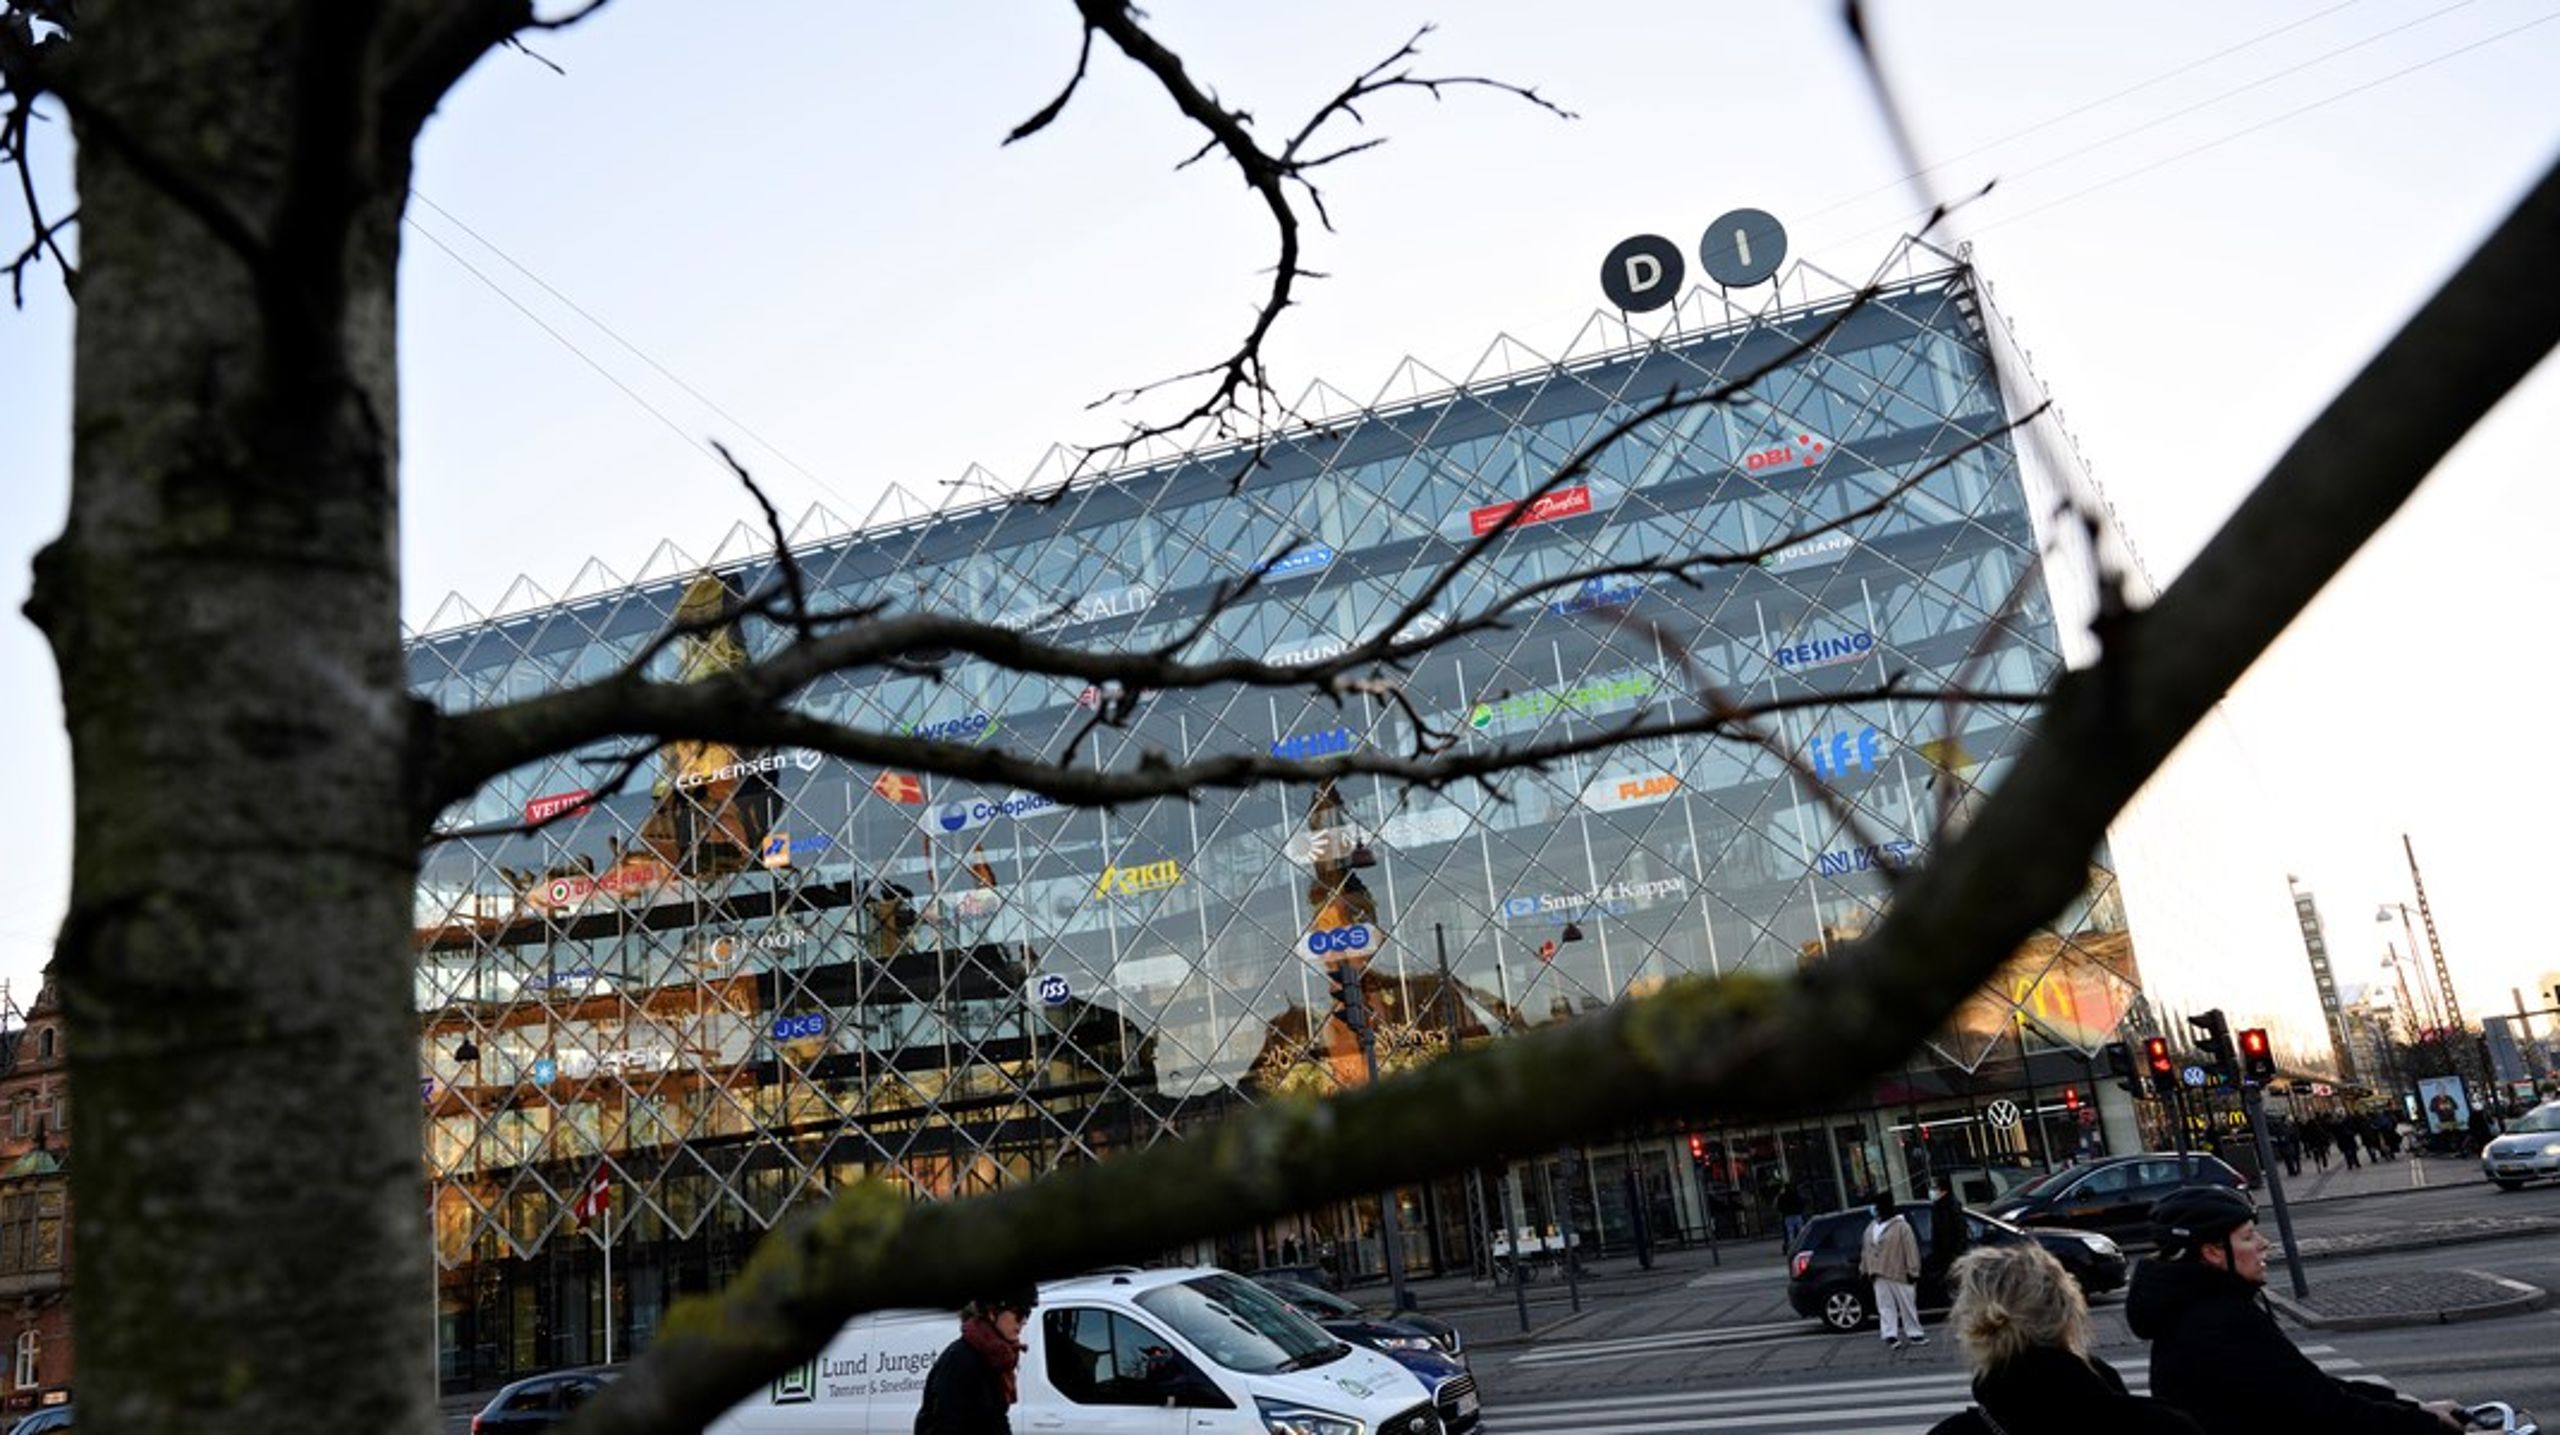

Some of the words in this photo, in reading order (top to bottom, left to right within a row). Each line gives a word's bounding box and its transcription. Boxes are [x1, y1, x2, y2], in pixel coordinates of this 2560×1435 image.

[1624, 253, 1662, 293] D
[1746, 447, 1792, 470] DBI
[1774, 535, 1855, 564] JULIANA
[1776, 633, 1872, 666] RESINO
[1811, 725, 1878, 781] iff
[973, 794, 1056, 821] Coloplas
[1820, 842, 1912, 878] NKT
[1095, 859, 1181, 901] ARKIL
[1618, 876, 1682, 900] Kappa
[1312, 929, 1367, 951] JKS
[776, 1017, 823, 1037] JKS
[822, 1353, 867, 1378] Lund
